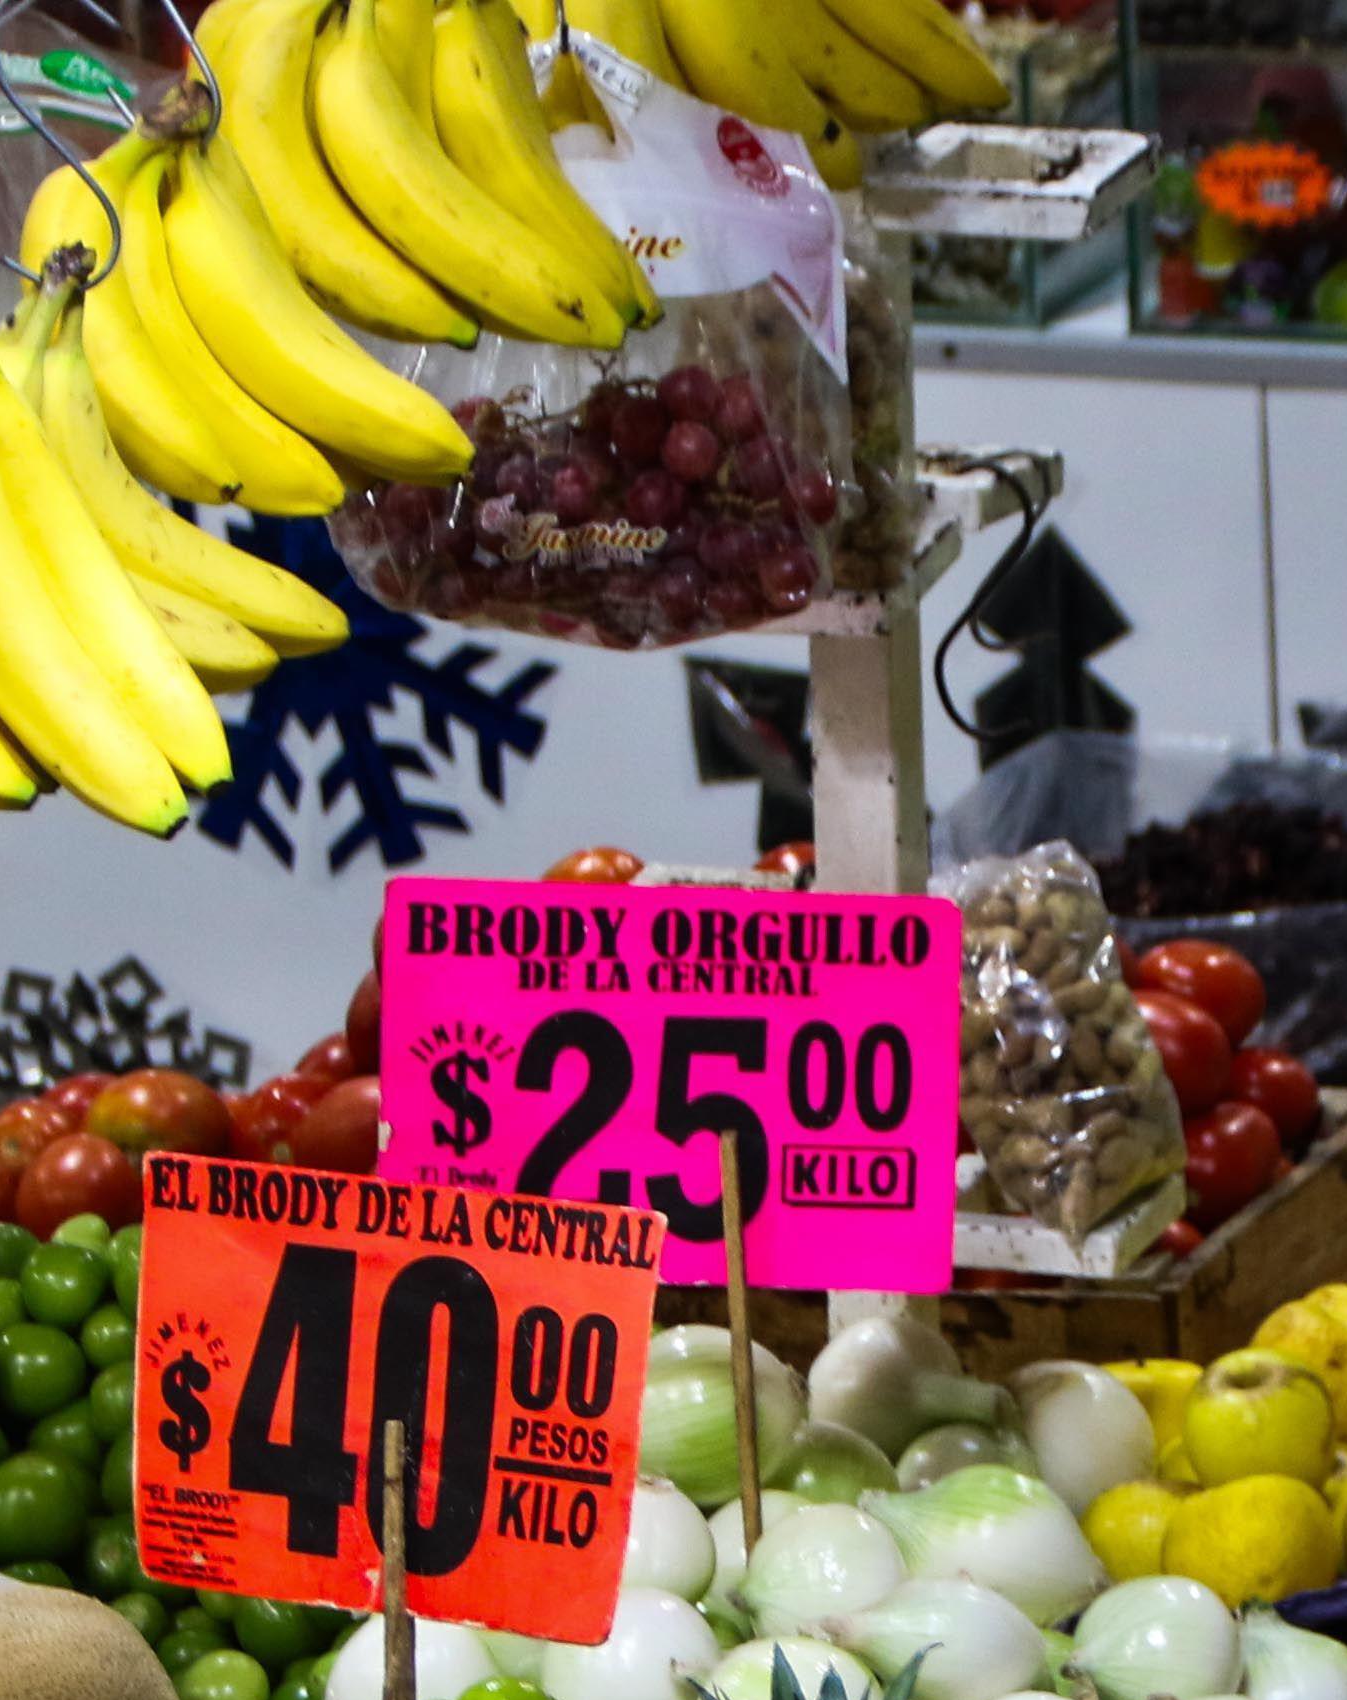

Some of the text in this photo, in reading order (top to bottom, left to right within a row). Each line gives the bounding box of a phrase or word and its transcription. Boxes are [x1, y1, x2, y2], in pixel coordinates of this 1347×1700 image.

[407, 902, 931, 968] BRODY ORGULLO
[517, 960, 818, 998] DE LA CENTRAL
[514, 1009, 769, 1243] 25
[786, 1019, 913, 1132] 00
[791, 1153, 900, 1197] KILO
[150, 1157, 655, 1270] EL BRODY DE LA CENTRAL
[144, 1312, 231, 1372] JIMENEZ
[229, 1242, 499, 1577] 40
[510, 1306, 618, 1418] 00
[509, 1416, 610, 1464] PESOS
[497, 1478, 598, 1549] KILO
